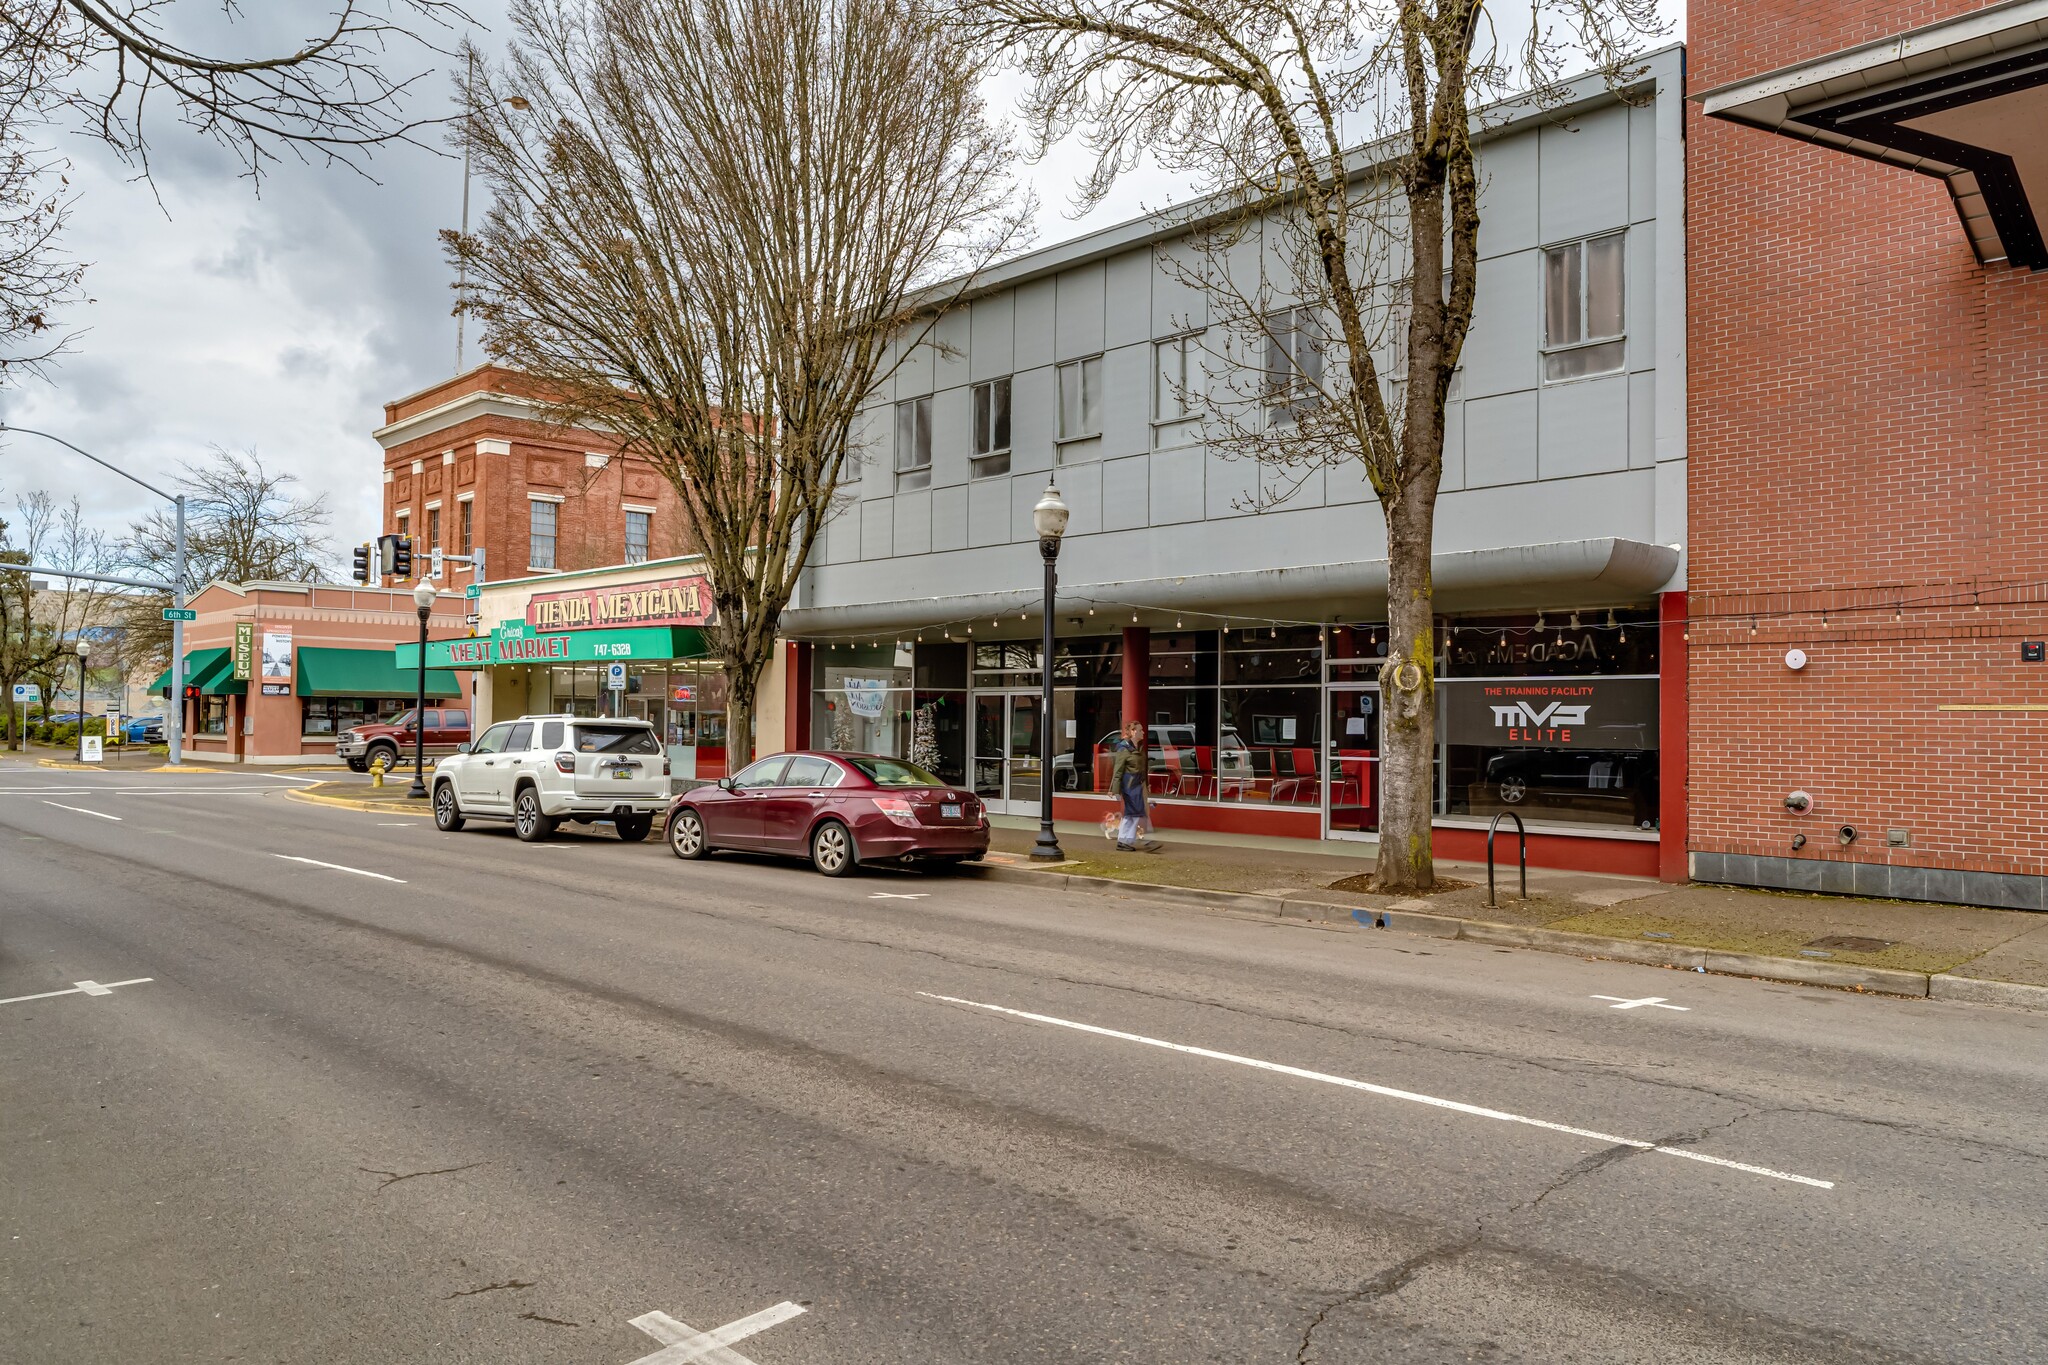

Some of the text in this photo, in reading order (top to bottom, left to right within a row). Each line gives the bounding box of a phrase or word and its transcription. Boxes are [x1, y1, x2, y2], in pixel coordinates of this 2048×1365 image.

[432, 549, 441, 559] ONE
[432, 559, 441, 567] WAY
[534, 585, 701, 627] TIENDA MEXICANA
[168, 610, 192, 619] 6th St
[501, 621, 523, 639] Erica's
[236, 626, 251, 678] MUSEUM
[450, 636, 631, 663] MEAT MARKET 747-6328
[1484, 686, 1594, 696] THE TRAINING FACILITY
[1509, 729, 1571, 742] ELITE
